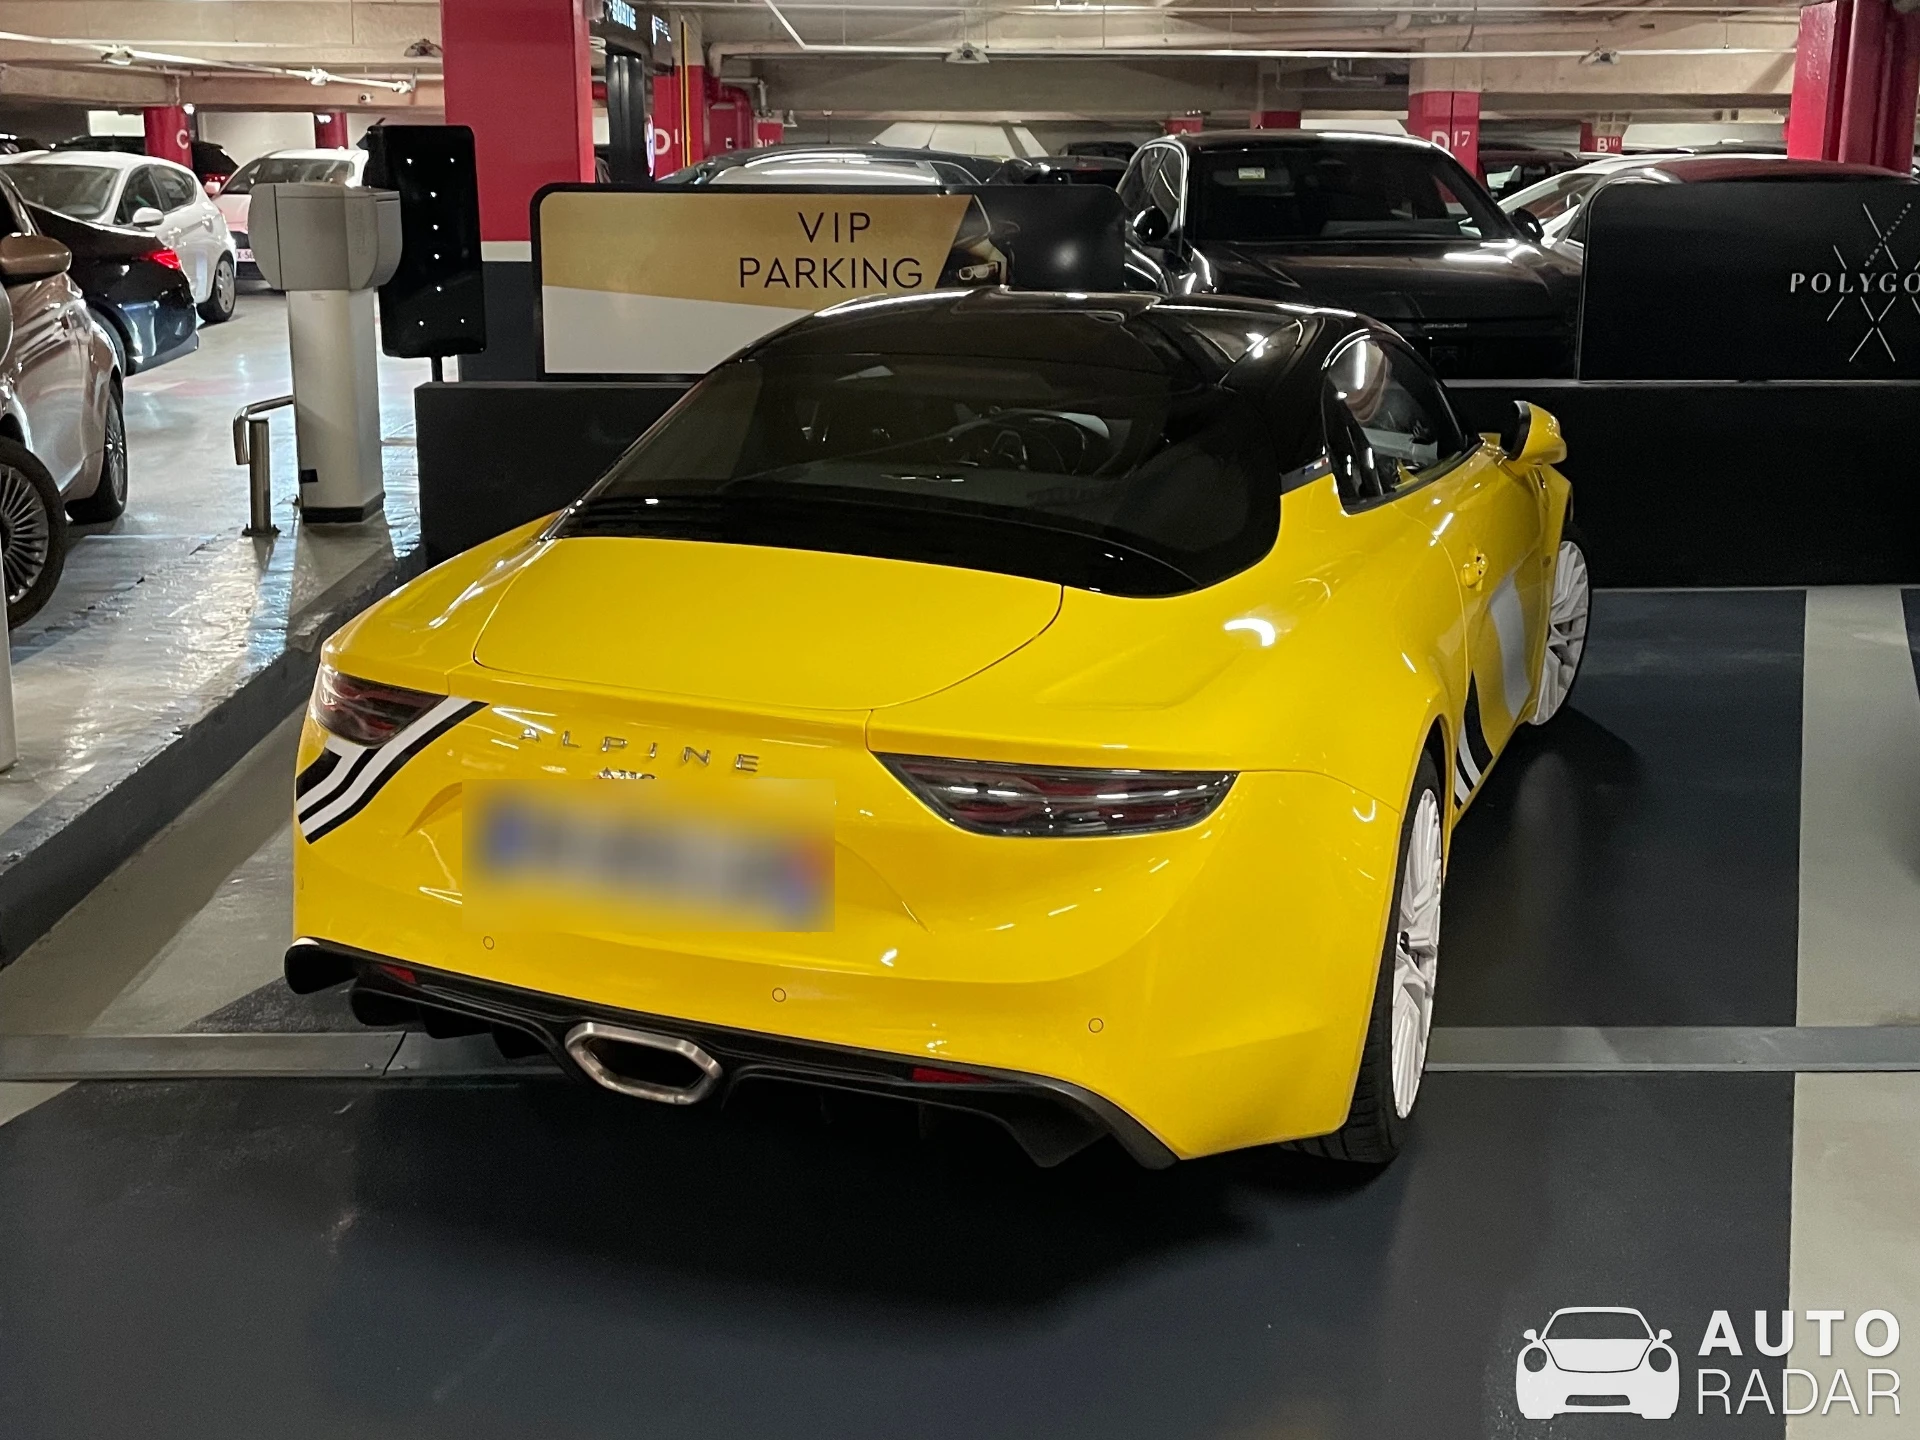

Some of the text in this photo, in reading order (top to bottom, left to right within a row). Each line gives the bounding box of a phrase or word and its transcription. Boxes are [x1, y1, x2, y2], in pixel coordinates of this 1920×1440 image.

[1431, 130, 1471, 151] D17
[1597, 136, 1619, 152] B16
[797, 211, 871, 243] VIP
[739, 257, 922, 289] PARKING
[1790, 272, 1920, 294] POLYGO
[518, 726, 760, 773] ALPINE
